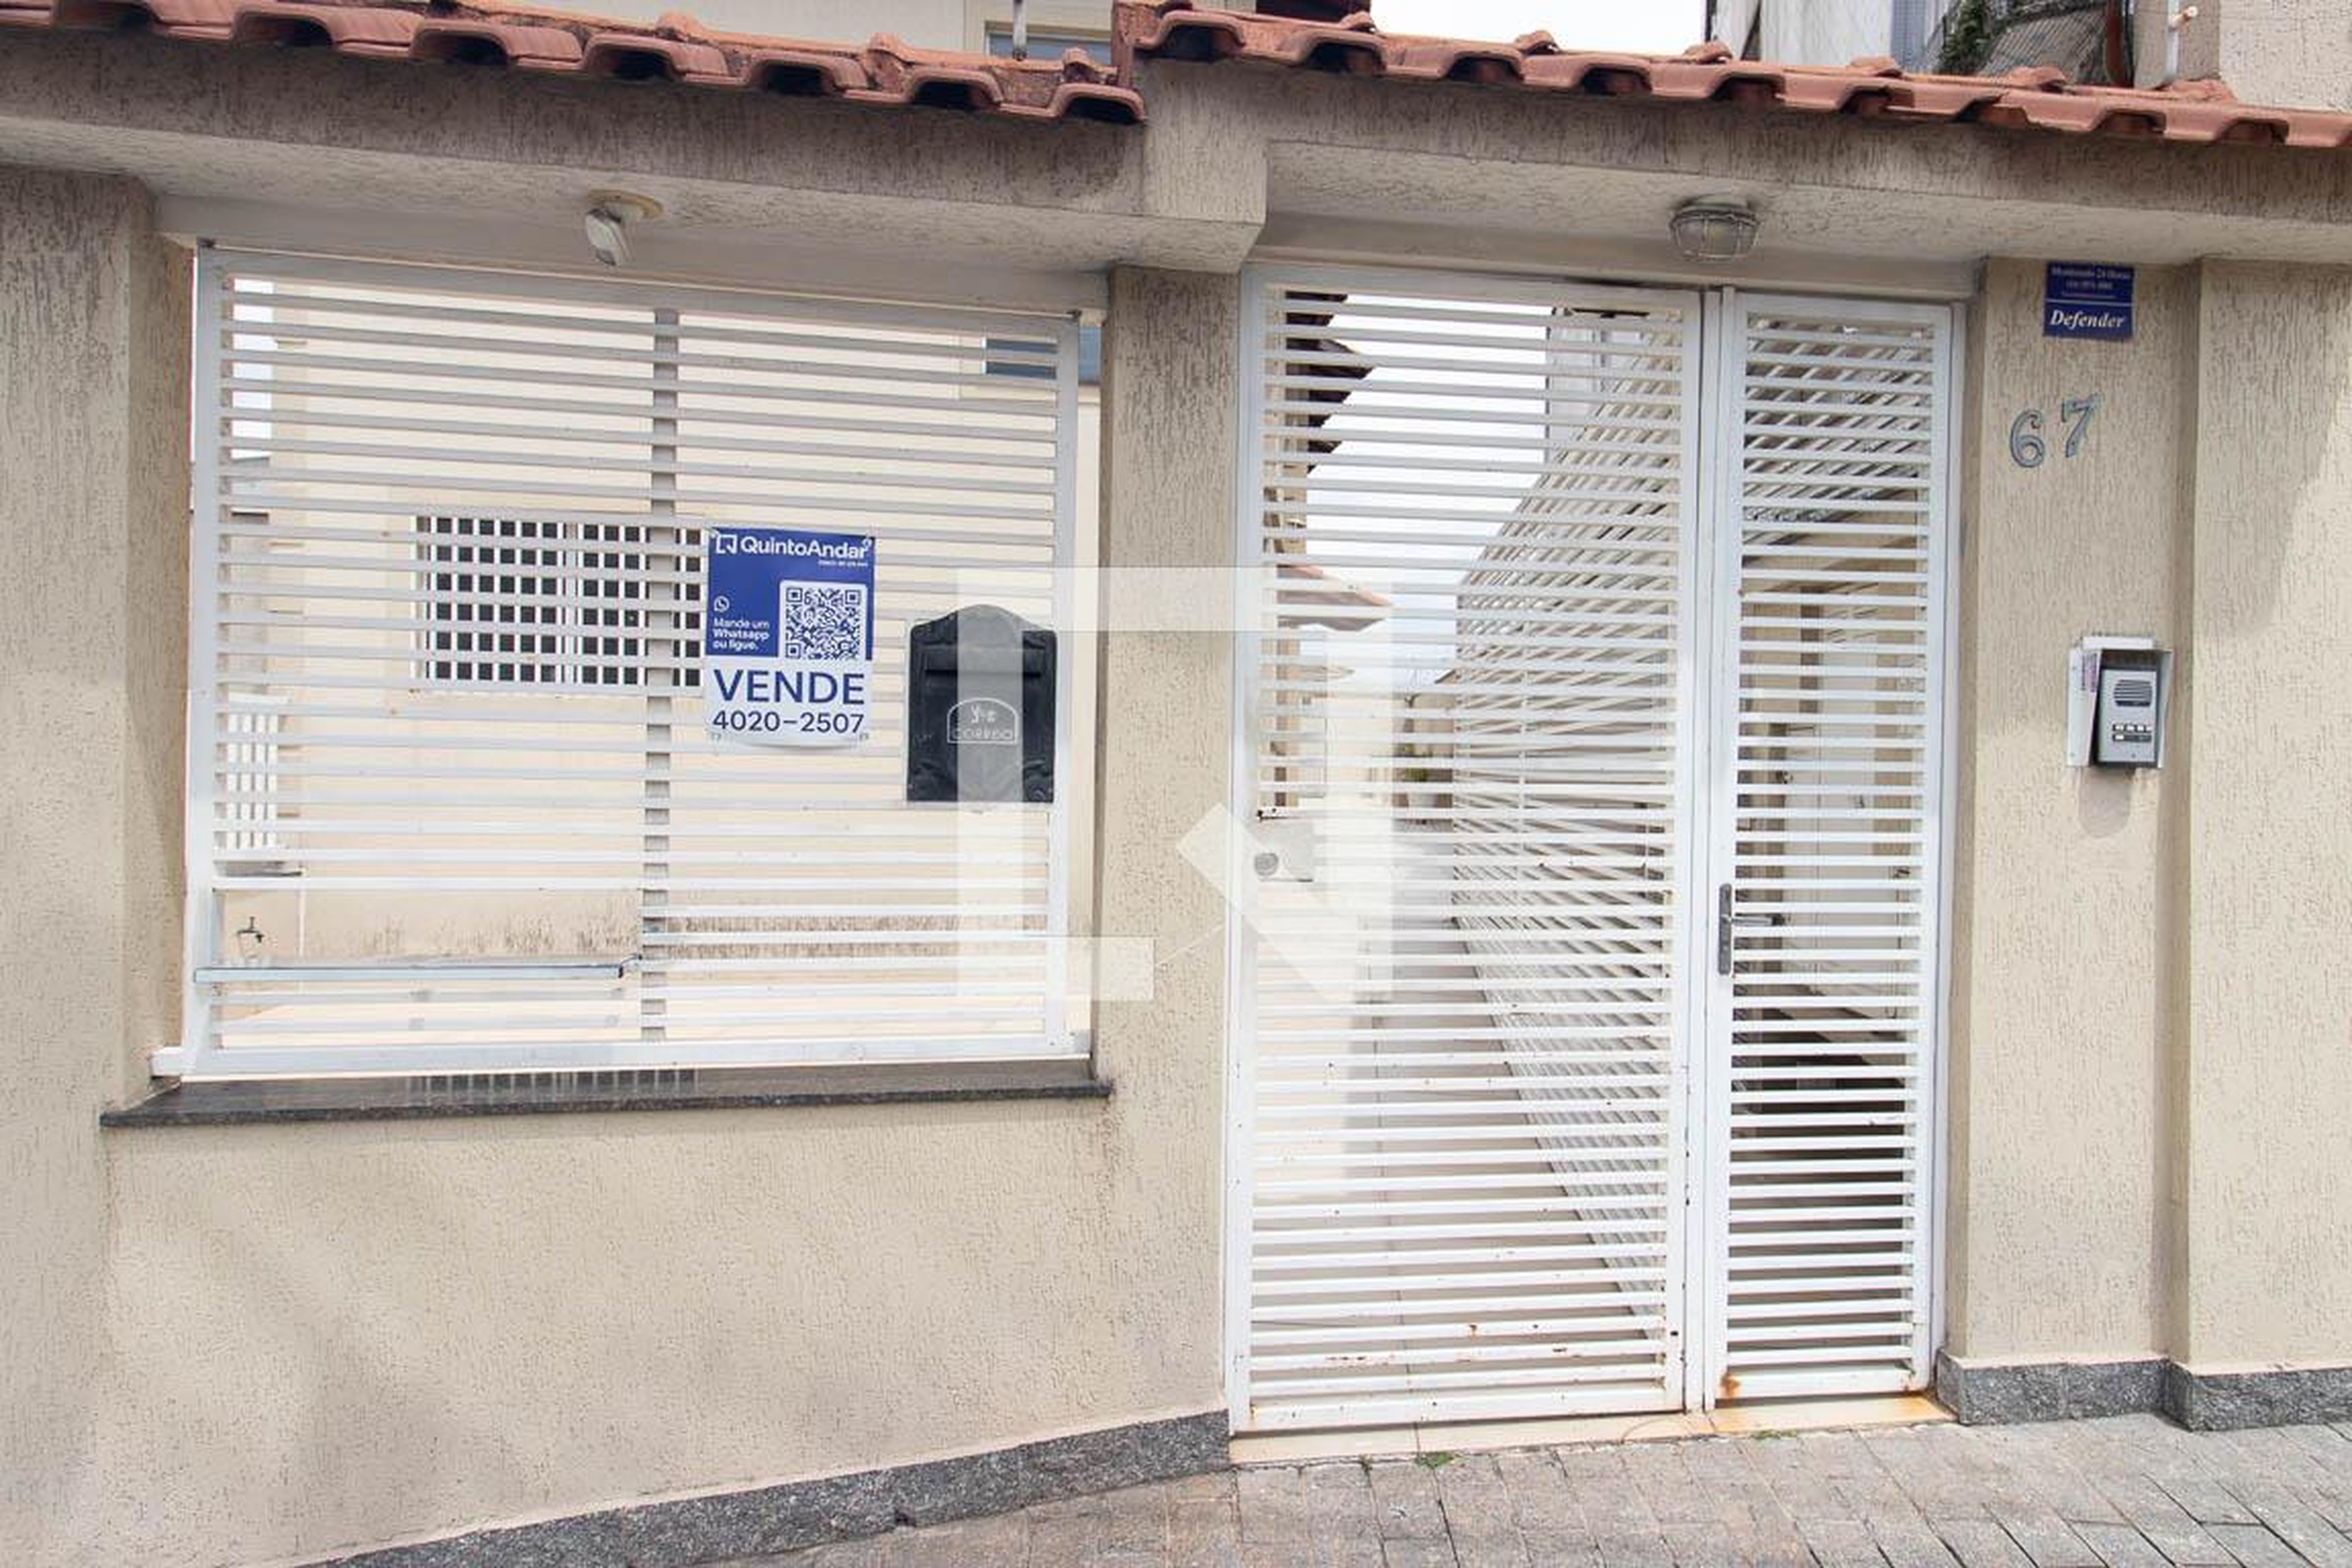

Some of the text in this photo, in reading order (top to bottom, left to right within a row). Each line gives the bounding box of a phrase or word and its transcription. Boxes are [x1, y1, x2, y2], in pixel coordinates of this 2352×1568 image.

[2050, 309, 2125, 330] Defender
[2009, 392, 2105, 469] 67
[740, 535, 865, 559] QuintoAndar
[712, 641, 727, 649] ou
[713, 668, 865, 705] VENDE
[712, 709, 865, 734] 4020-2507
